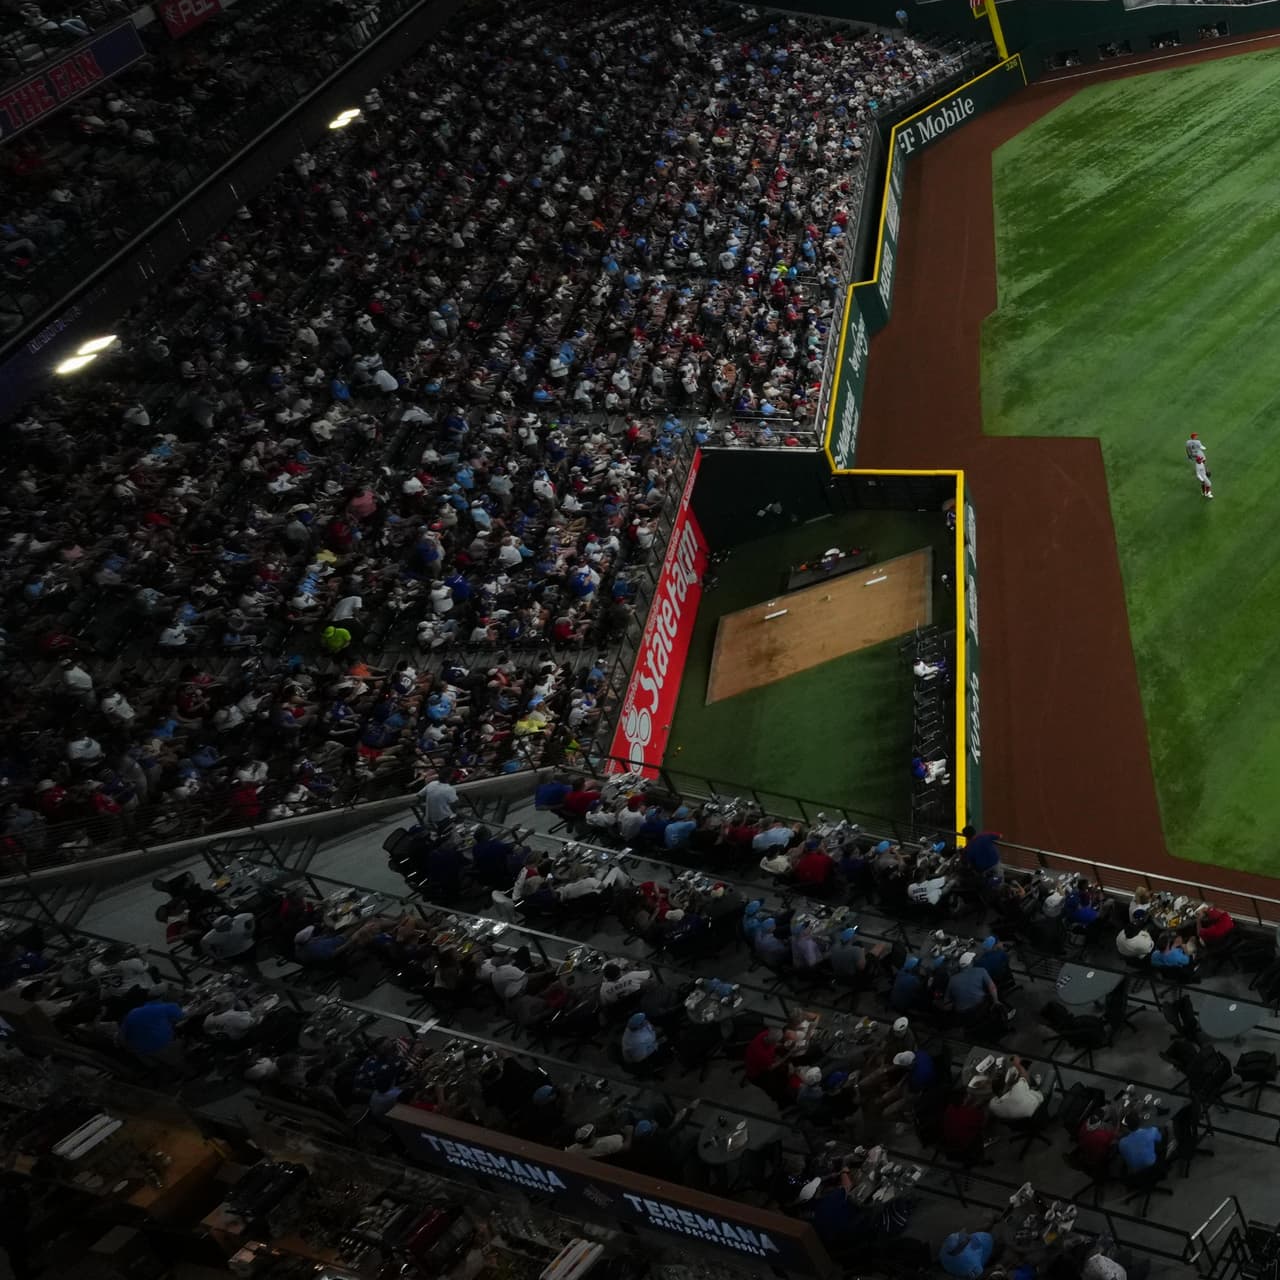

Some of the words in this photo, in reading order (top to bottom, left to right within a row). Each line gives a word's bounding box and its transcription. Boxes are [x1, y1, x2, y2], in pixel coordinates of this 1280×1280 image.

[916, 97, 975, 145] Mobile
[421, 1132, 567, 1190] TEREMANA
[623, 1193, 780, 1254] TEREMANA
